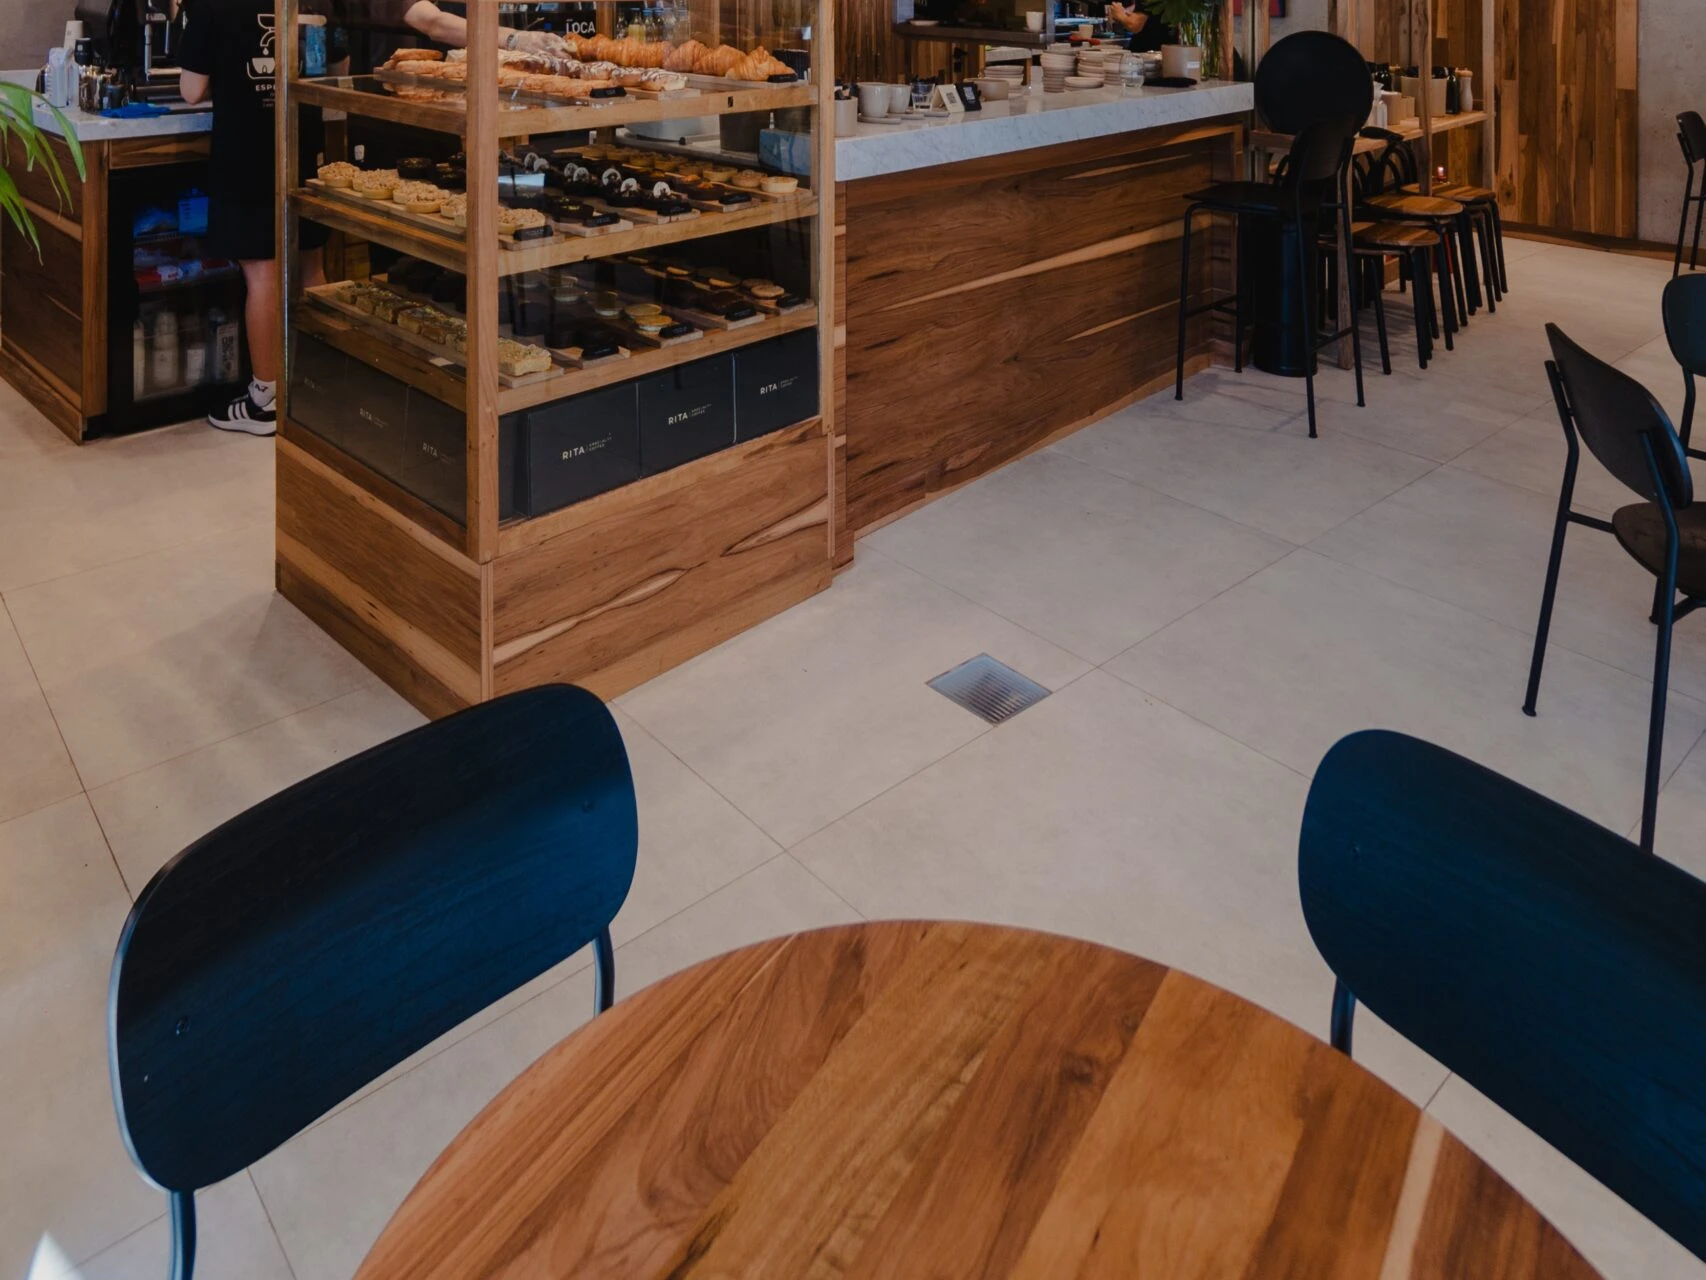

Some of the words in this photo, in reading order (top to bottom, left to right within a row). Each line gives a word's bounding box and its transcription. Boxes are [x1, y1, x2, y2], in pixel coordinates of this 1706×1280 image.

[255, 84, 275, 92] ESP
[760, 383, 778, 395] RITA
[668, 412, 688, 425] RITA
[562, 446, 585, 460] RITA
